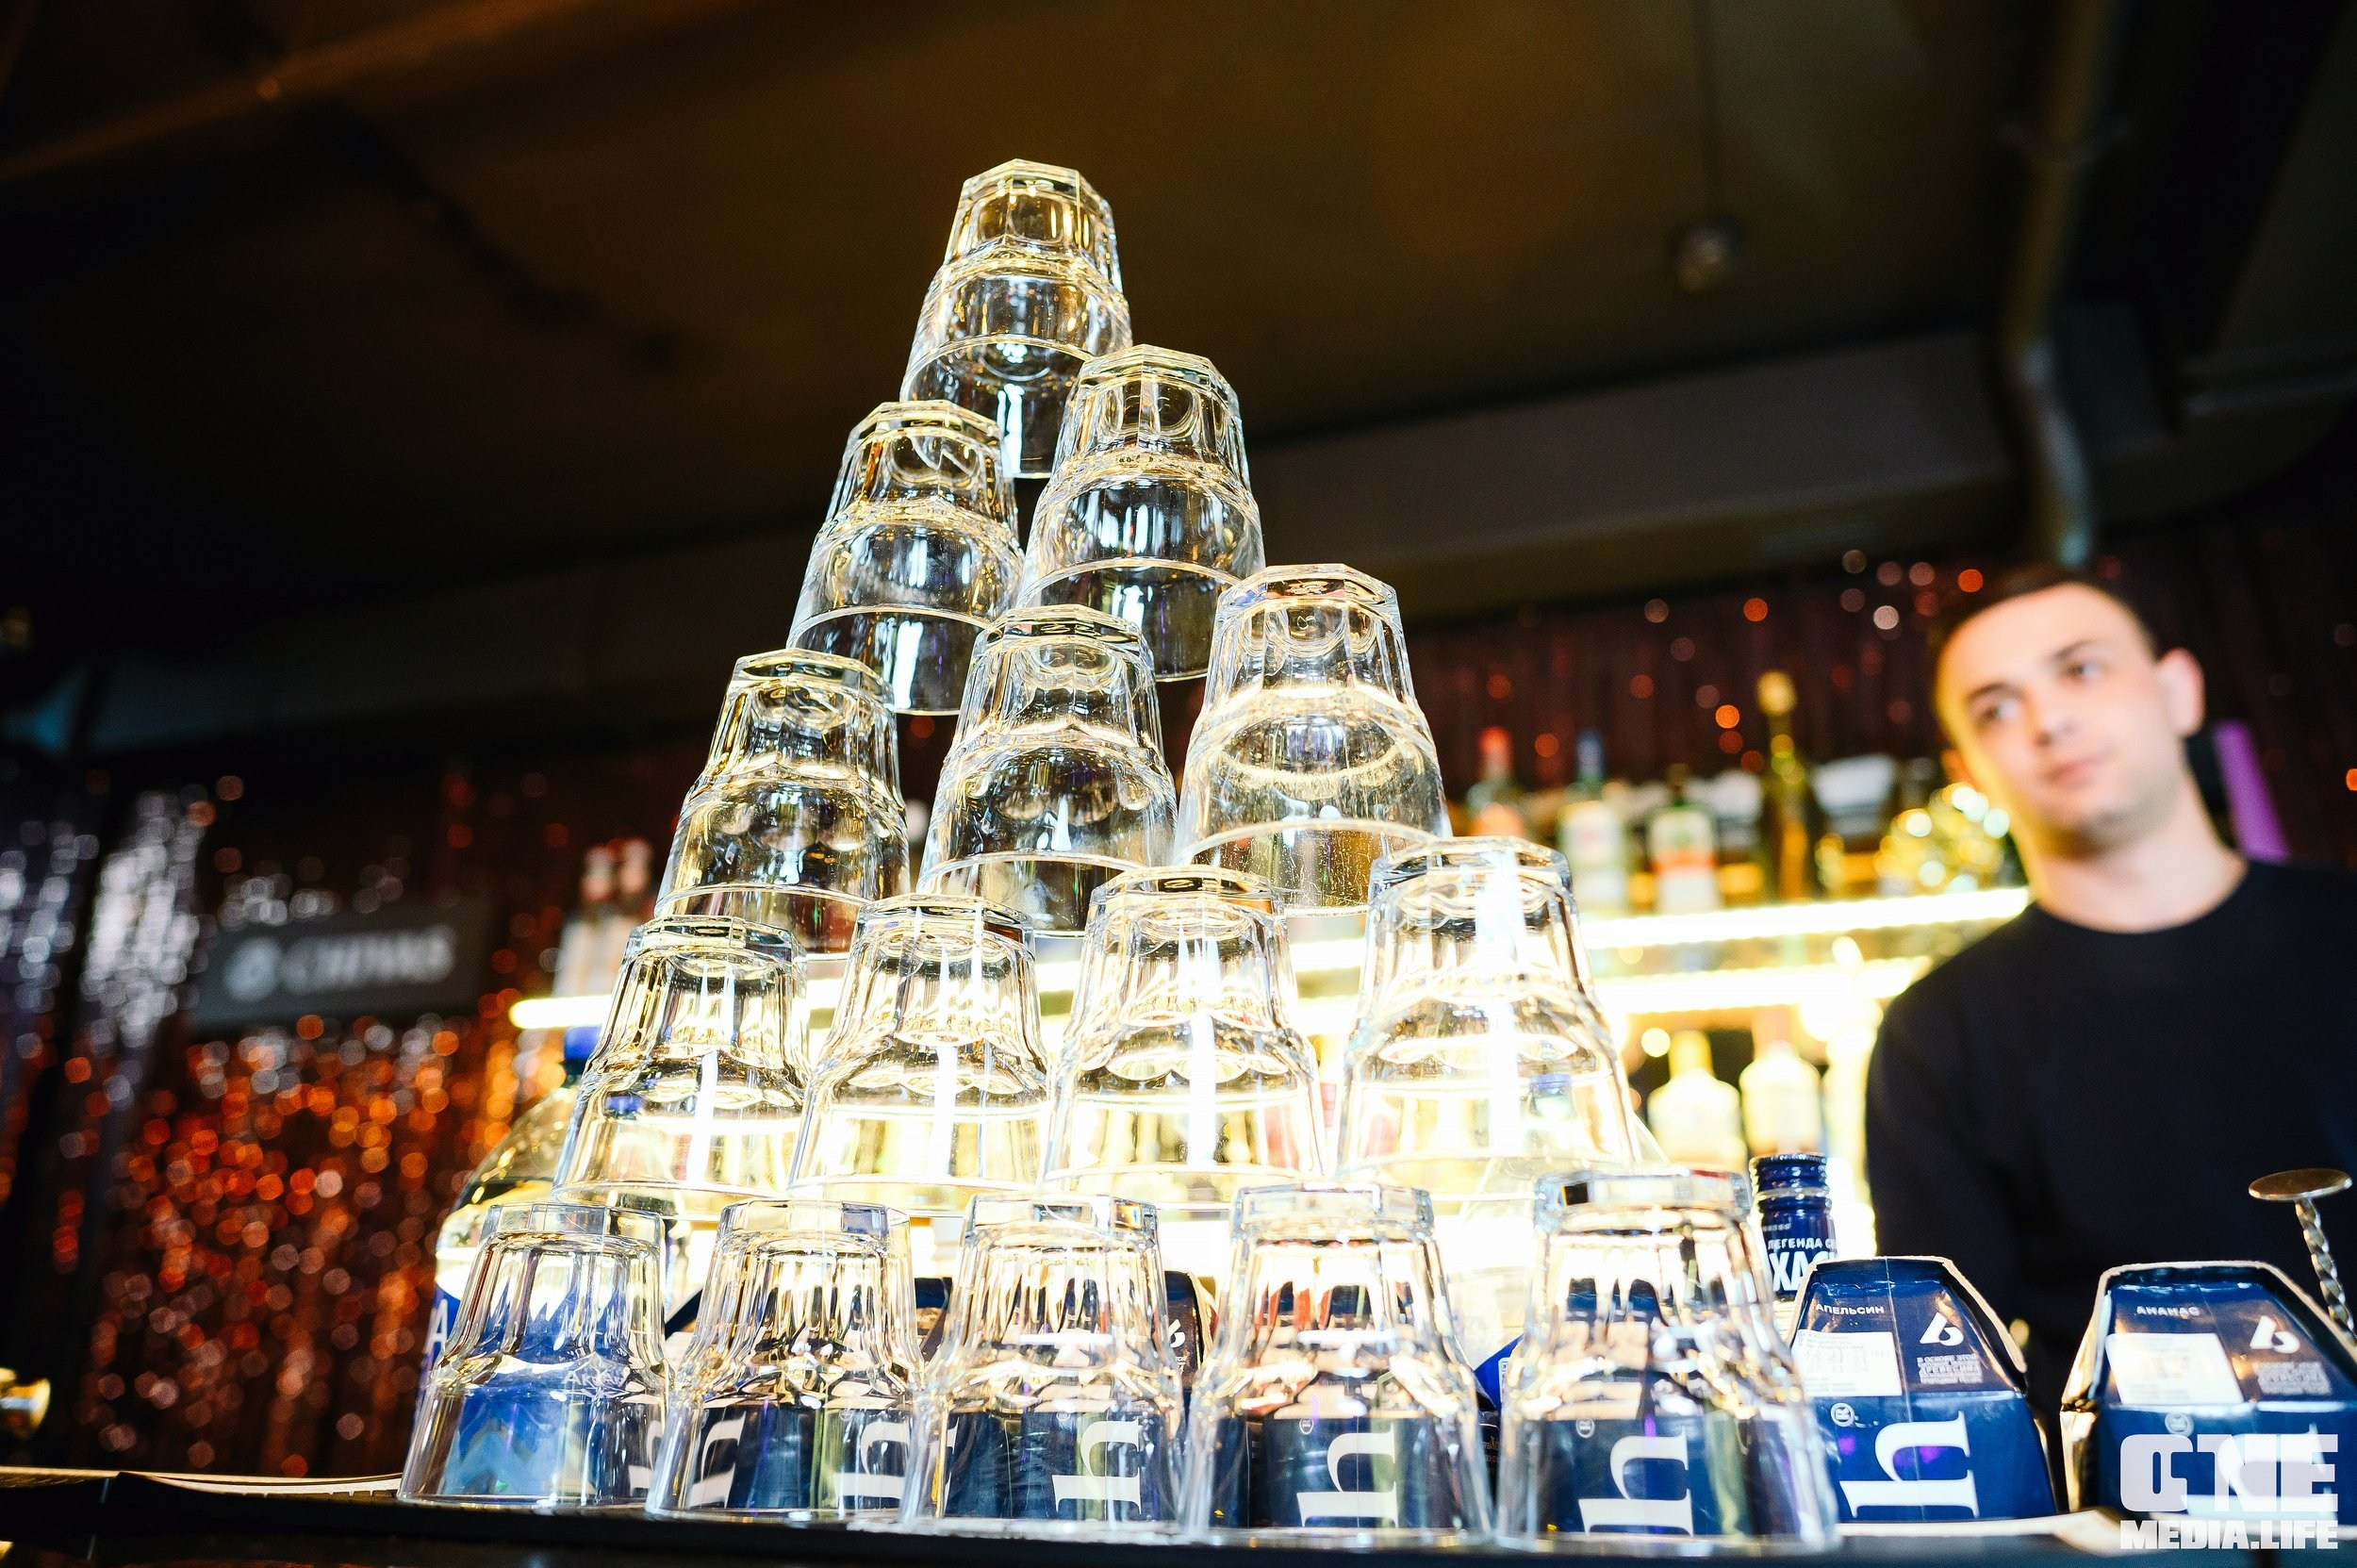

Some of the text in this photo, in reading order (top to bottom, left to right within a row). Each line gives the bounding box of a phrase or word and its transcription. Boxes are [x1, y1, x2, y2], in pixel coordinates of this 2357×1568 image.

[1768, 1237, 1823, 1250] ЛЕГЕНДА
[1816, 1303, 1885, 1315] АПЕЛЬСИН
[2136, 1305, 2200, 1316] АНАНАС
